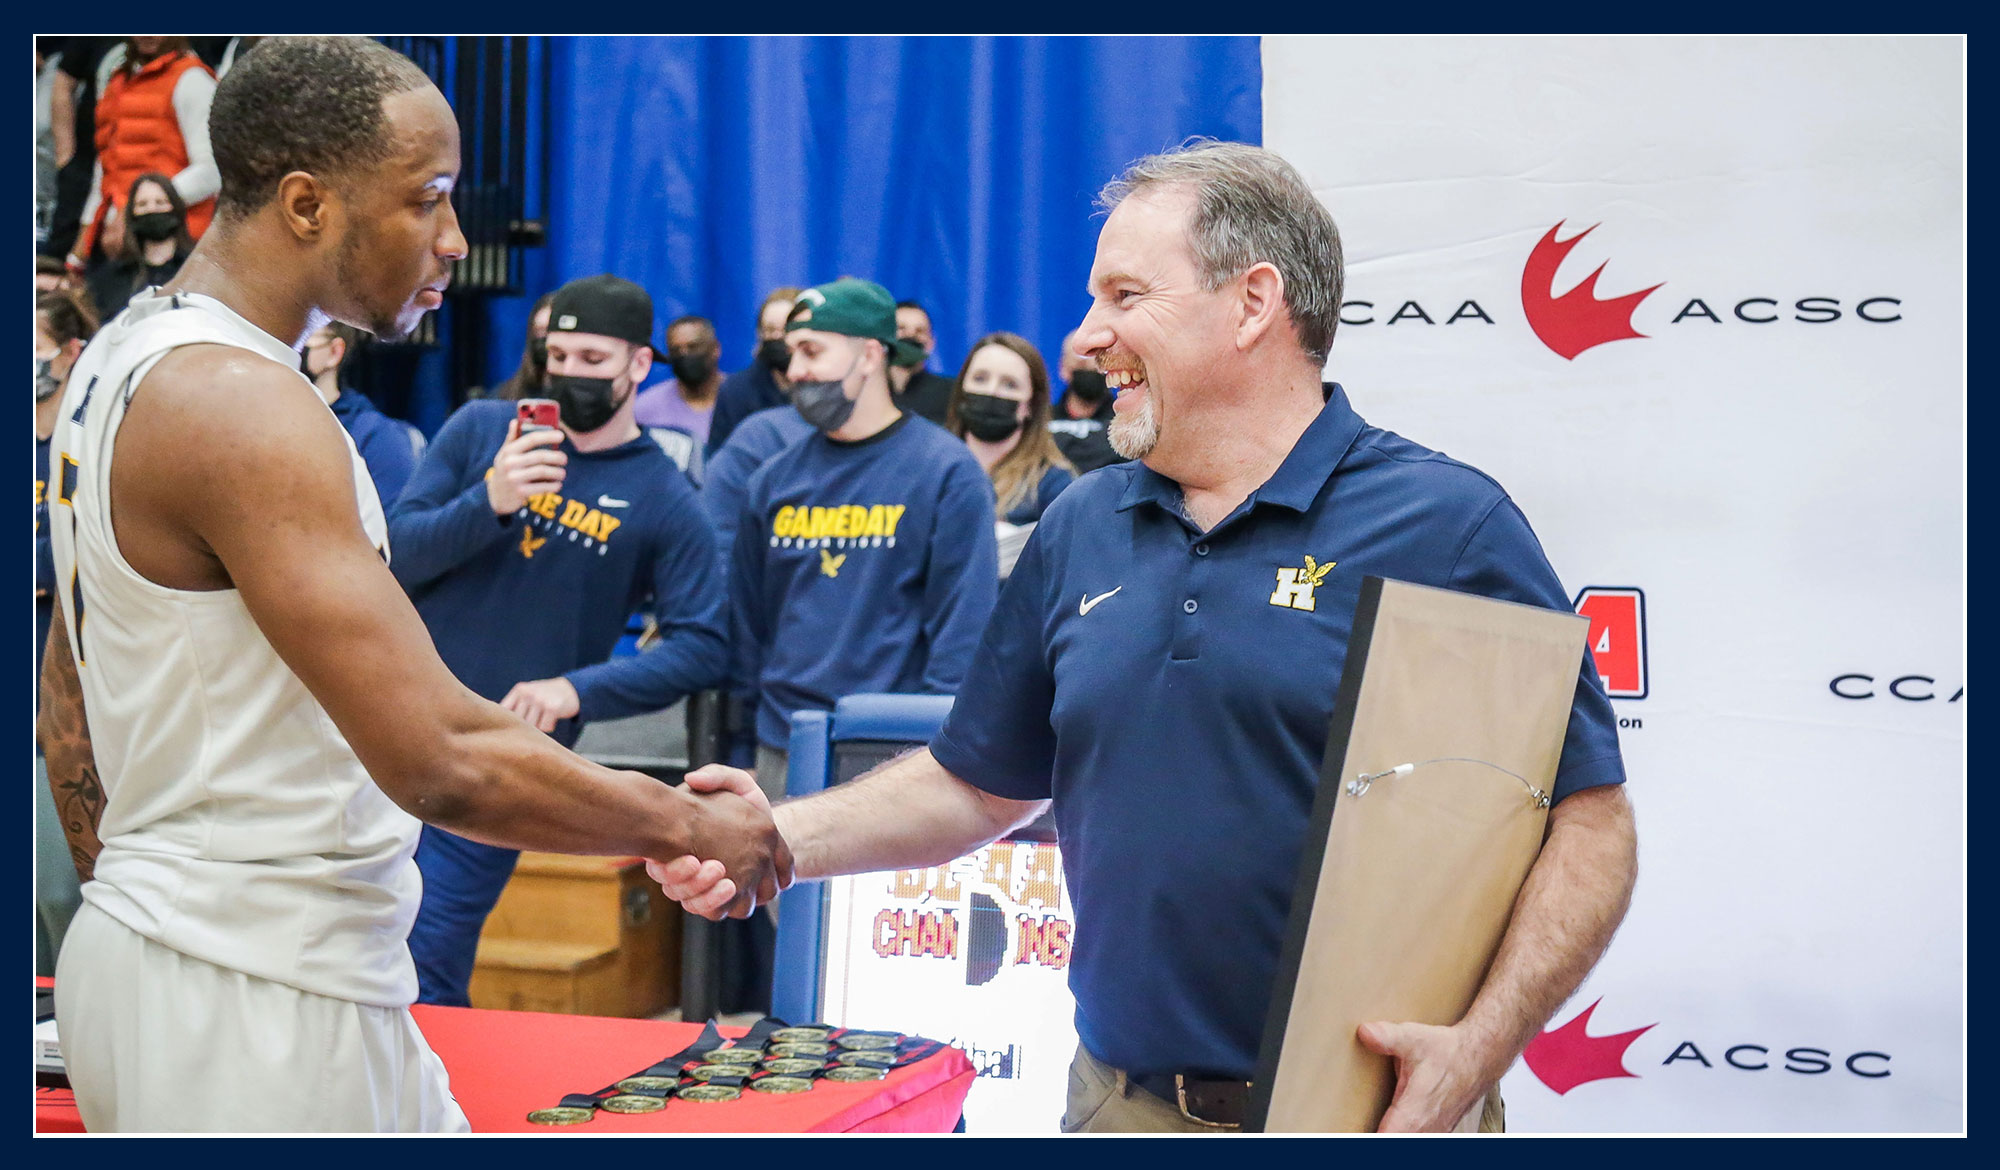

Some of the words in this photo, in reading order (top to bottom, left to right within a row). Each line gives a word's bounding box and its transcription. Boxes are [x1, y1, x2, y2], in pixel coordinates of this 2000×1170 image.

[1339, 300, 1495, 325] CAA
[1671, 297, 1902, 324] ACSC
[559, 498, 622, 542] DAY
[772, 503, 906, 539] GAMEDAY
[1573, 587, 1648, 699] A
[1614, 713, 1643, 729] on
[1661, 1041, 1892, 1079] ACSC
